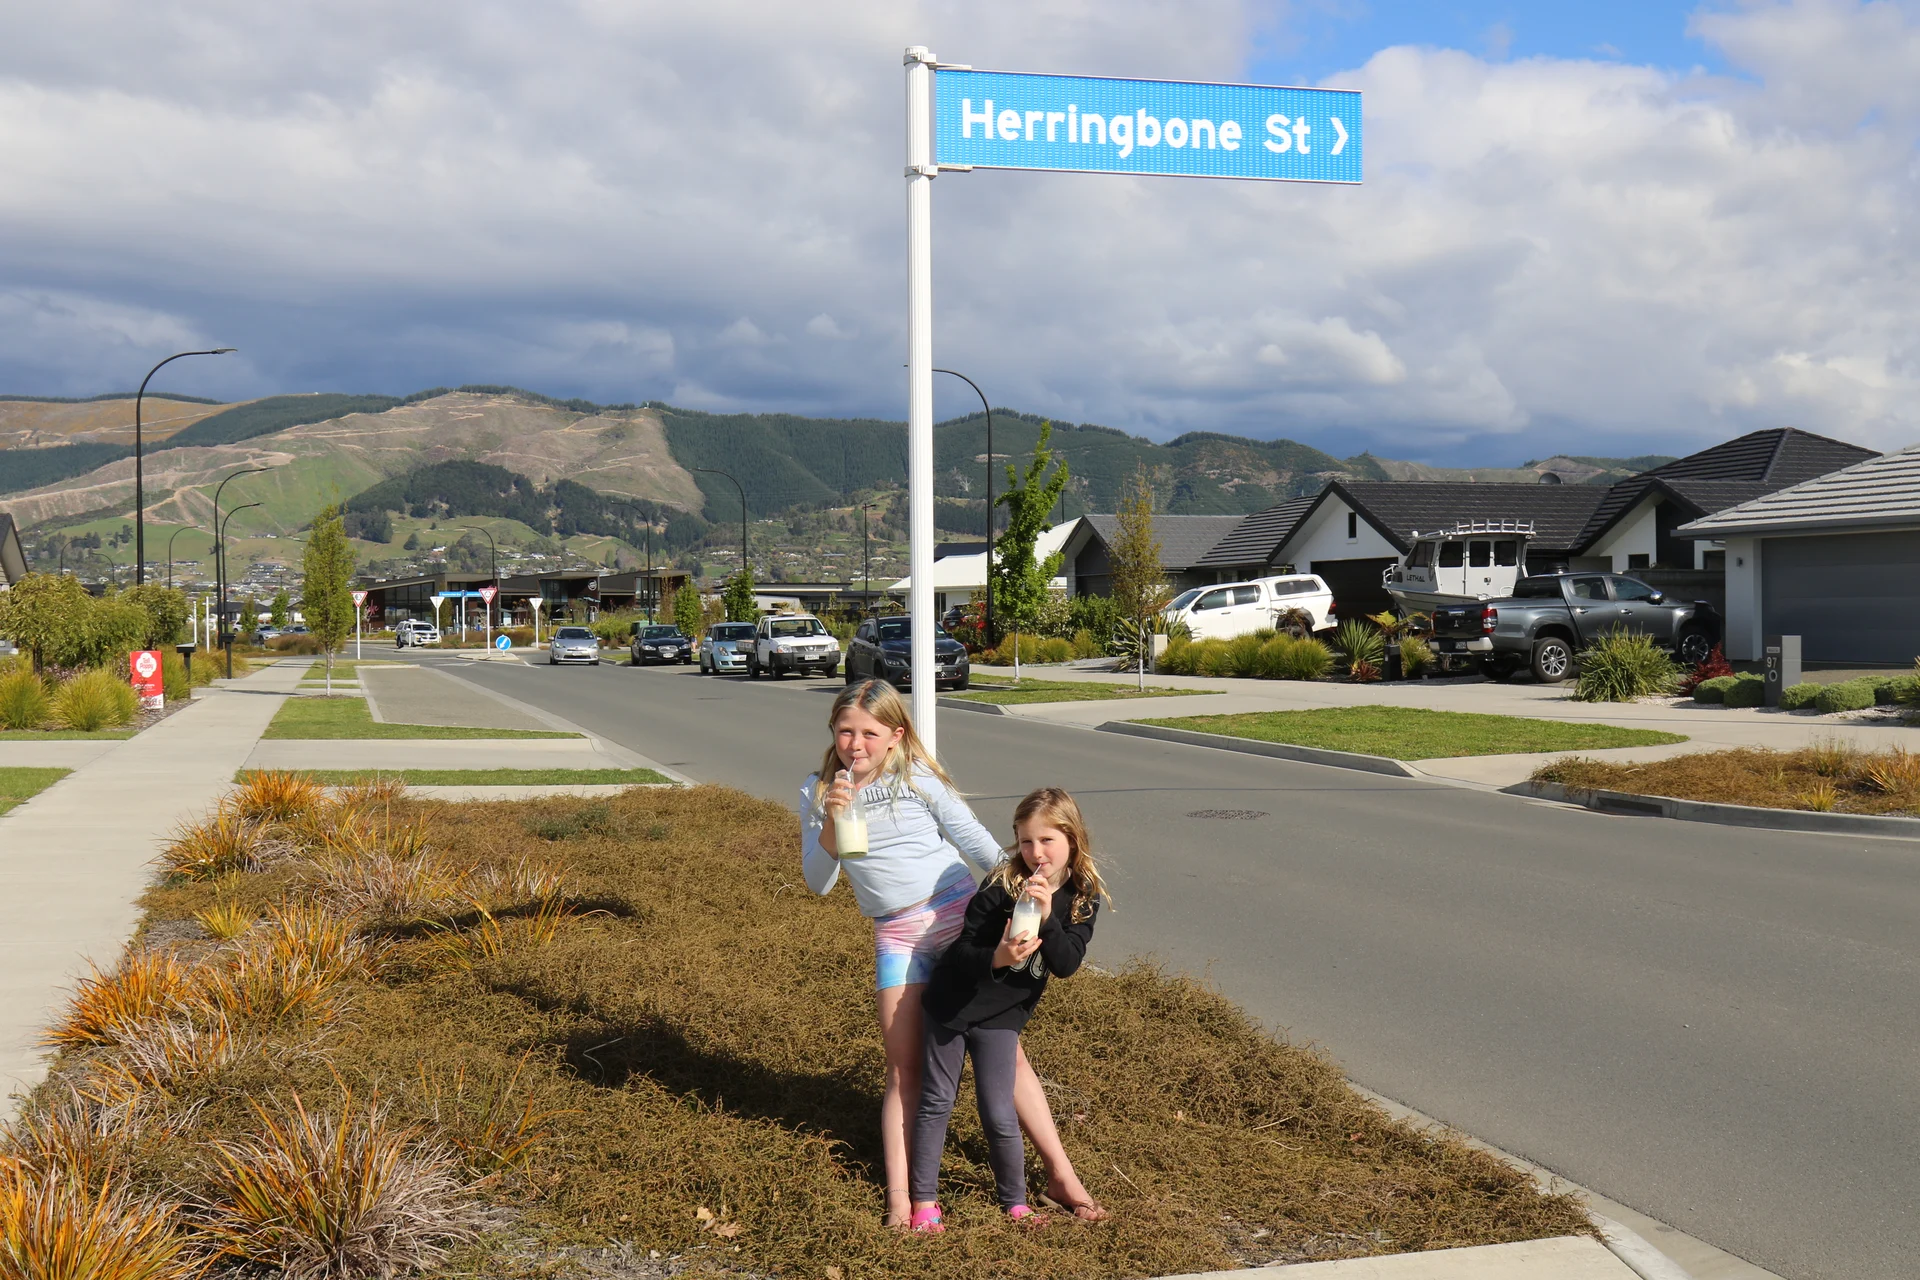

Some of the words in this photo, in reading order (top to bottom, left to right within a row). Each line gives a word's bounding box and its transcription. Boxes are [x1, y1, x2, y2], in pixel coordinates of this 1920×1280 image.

[962, 98, 1243, 159] Herringbone
[1264, 113, 1311, 154] St
[1406, 574, 1425, 583] LETHAL
[1766, 656, 1778, 668] 97
